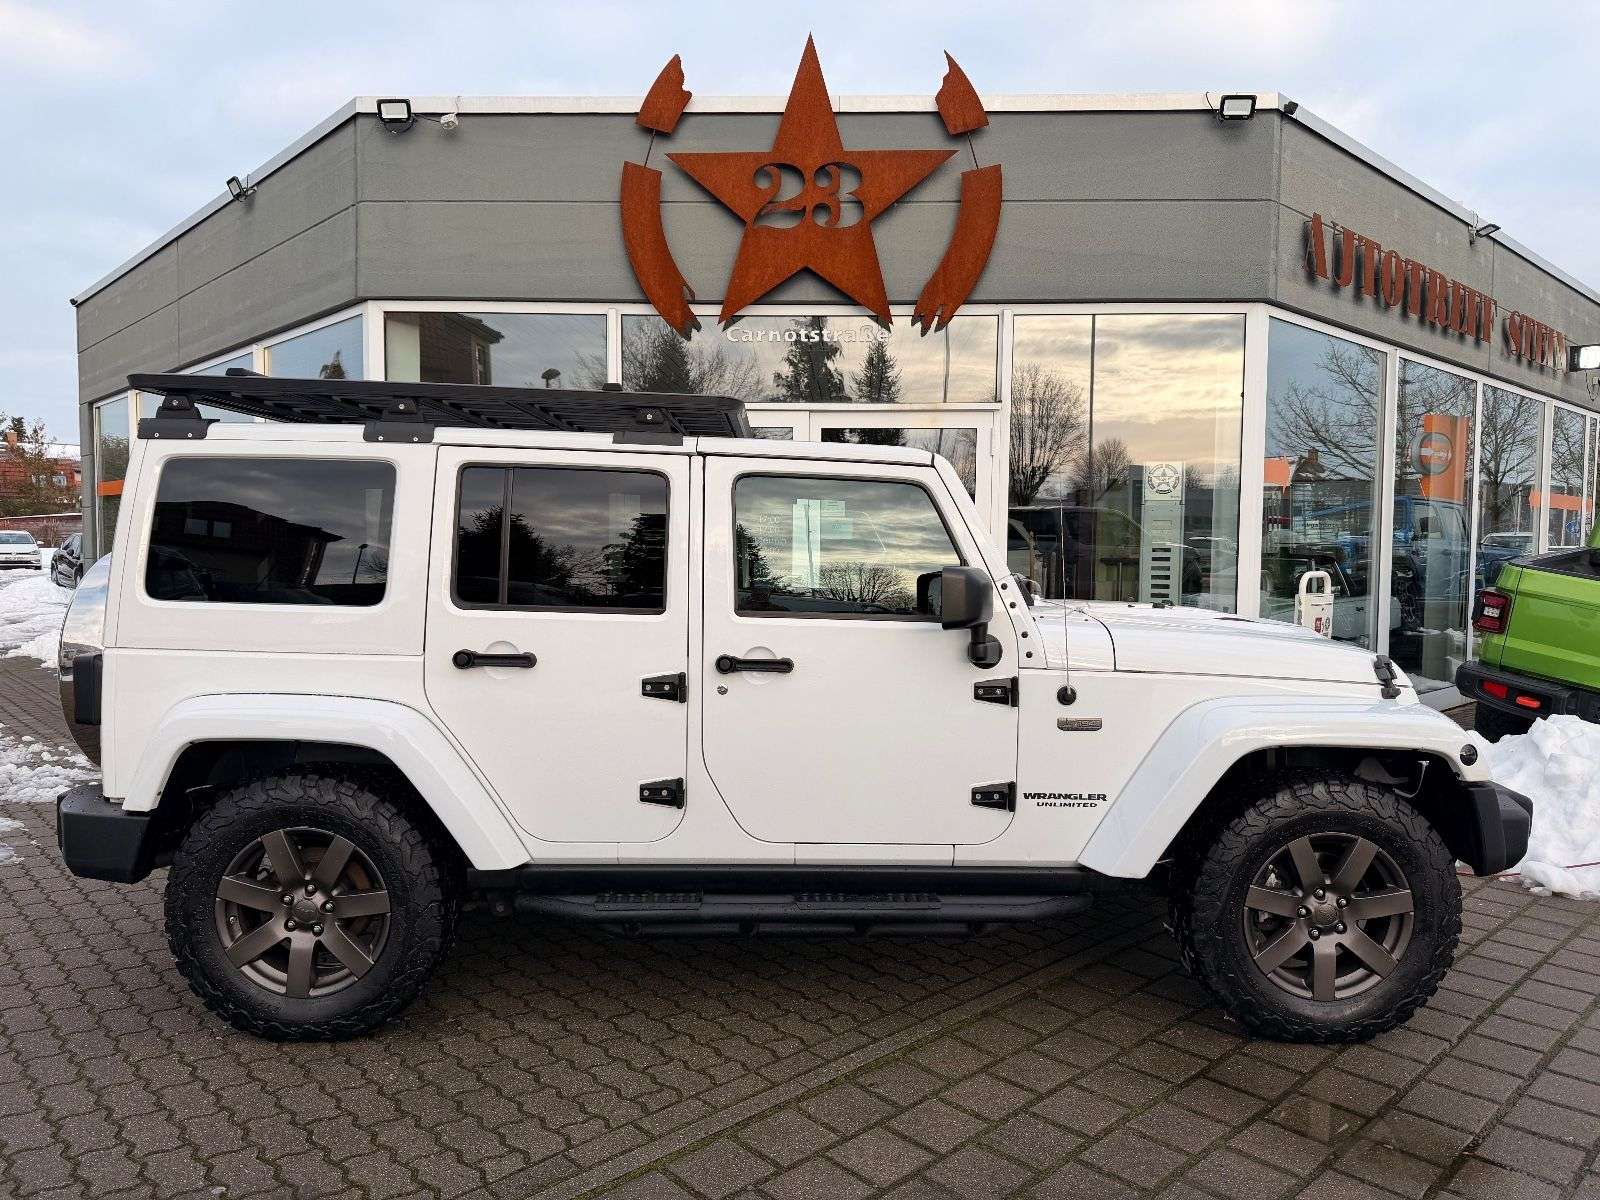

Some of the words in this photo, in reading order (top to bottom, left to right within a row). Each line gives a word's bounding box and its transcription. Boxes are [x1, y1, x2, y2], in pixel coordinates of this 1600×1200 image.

[753, 161, 865, 230] 23
[726, 324, 889, 343] Carnotstraße
[1023, 792, 1107, 801] WRANGLER
